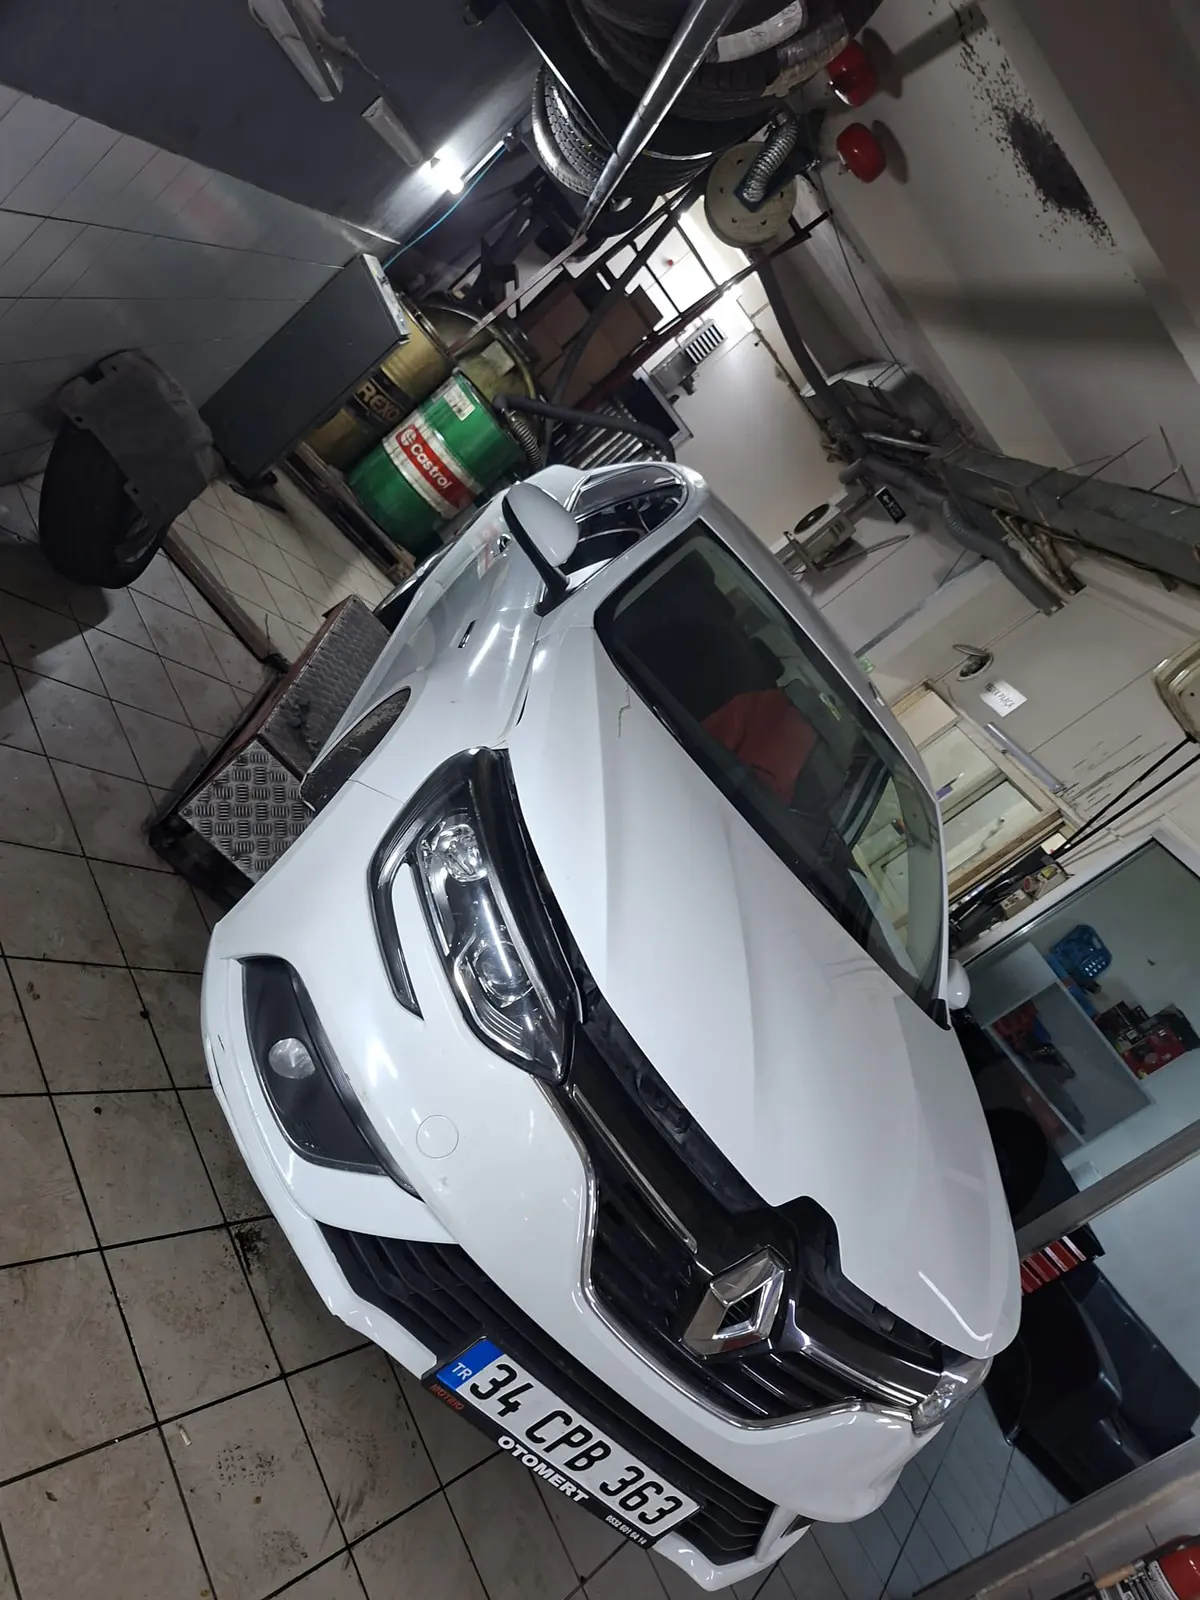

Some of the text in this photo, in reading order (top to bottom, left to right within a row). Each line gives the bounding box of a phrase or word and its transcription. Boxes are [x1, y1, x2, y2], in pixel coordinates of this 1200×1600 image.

[410, 443, 453, 490] Castrol
[452, 1361, 684, 1525] TR 34 CPB 363
[497, 1435, 590, 1502] OTOMERT
